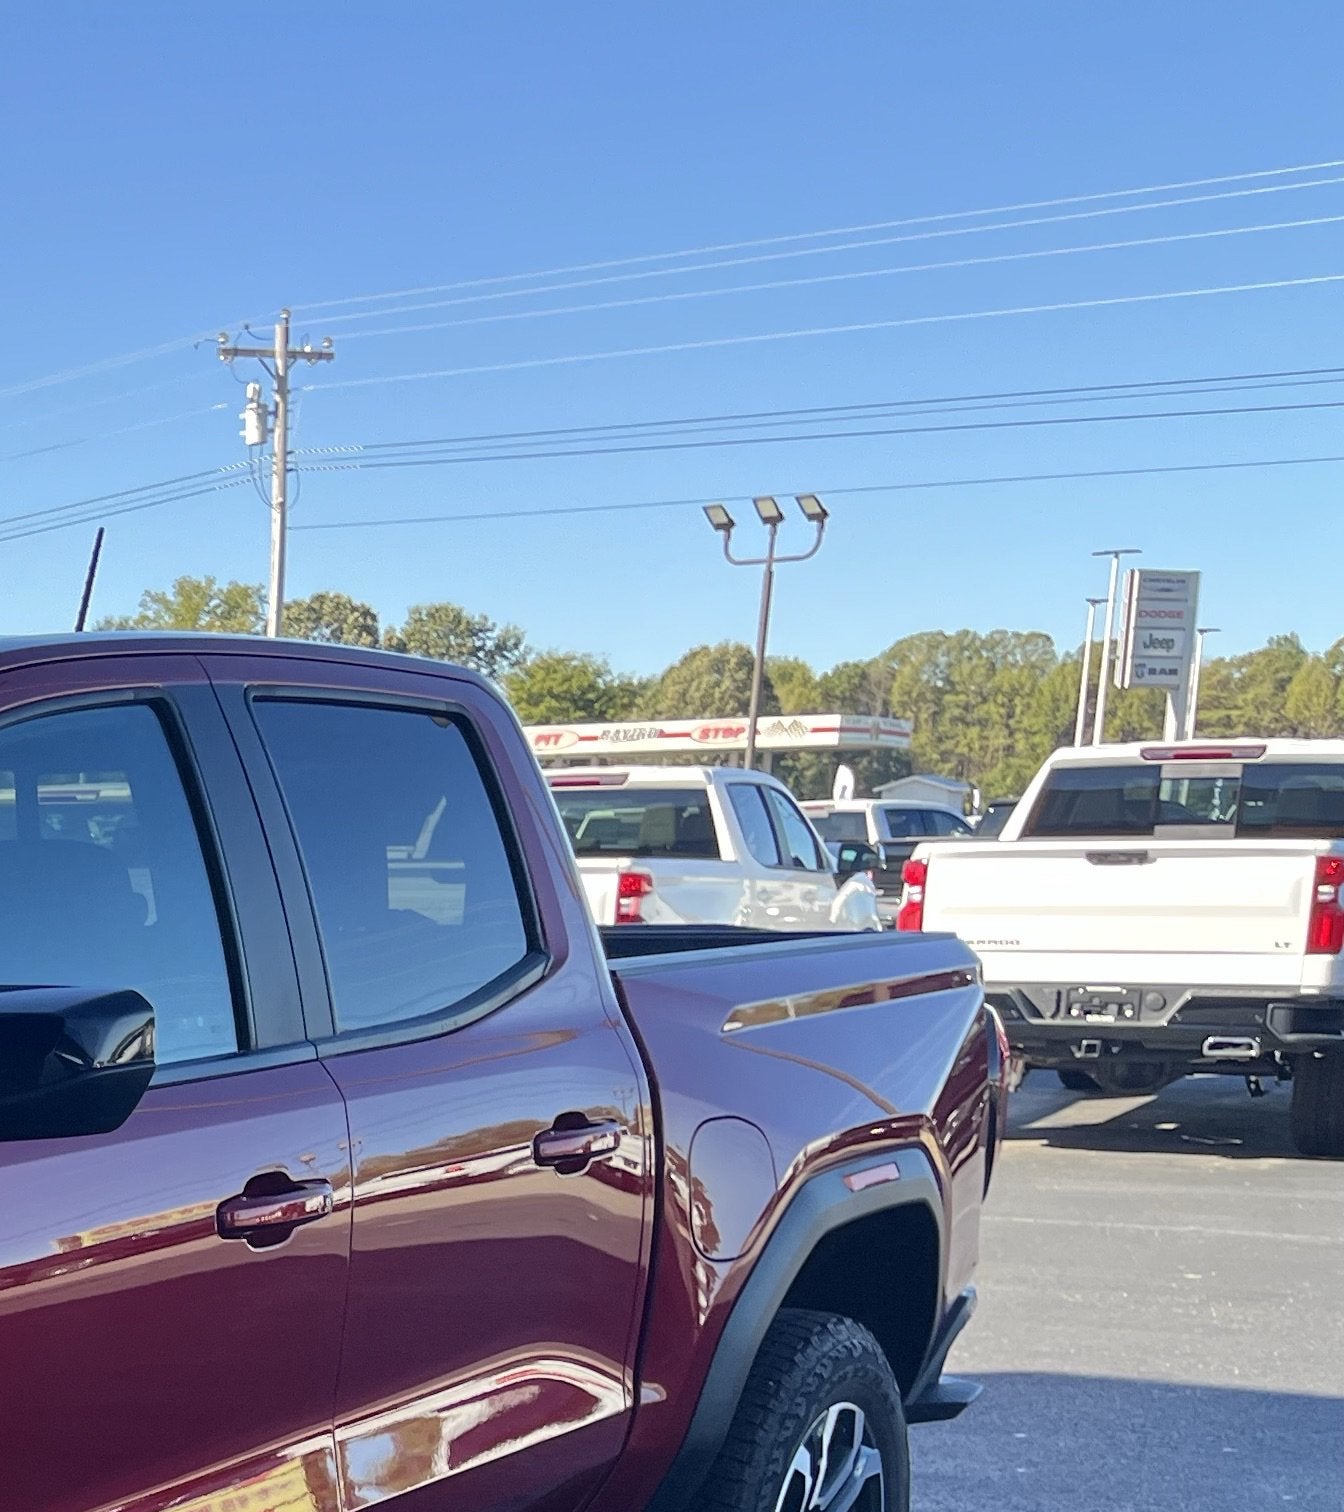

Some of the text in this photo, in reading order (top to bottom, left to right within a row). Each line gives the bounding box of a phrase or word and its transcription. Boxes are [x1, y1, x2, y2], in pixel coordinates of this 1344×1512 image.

[1138, 610, 1185, 619] DODGE
[1142, 633, 1175, 653] Jeep
[1148, 667, 1178, 676] RAM
[698, 727, 746, 740] STOP
